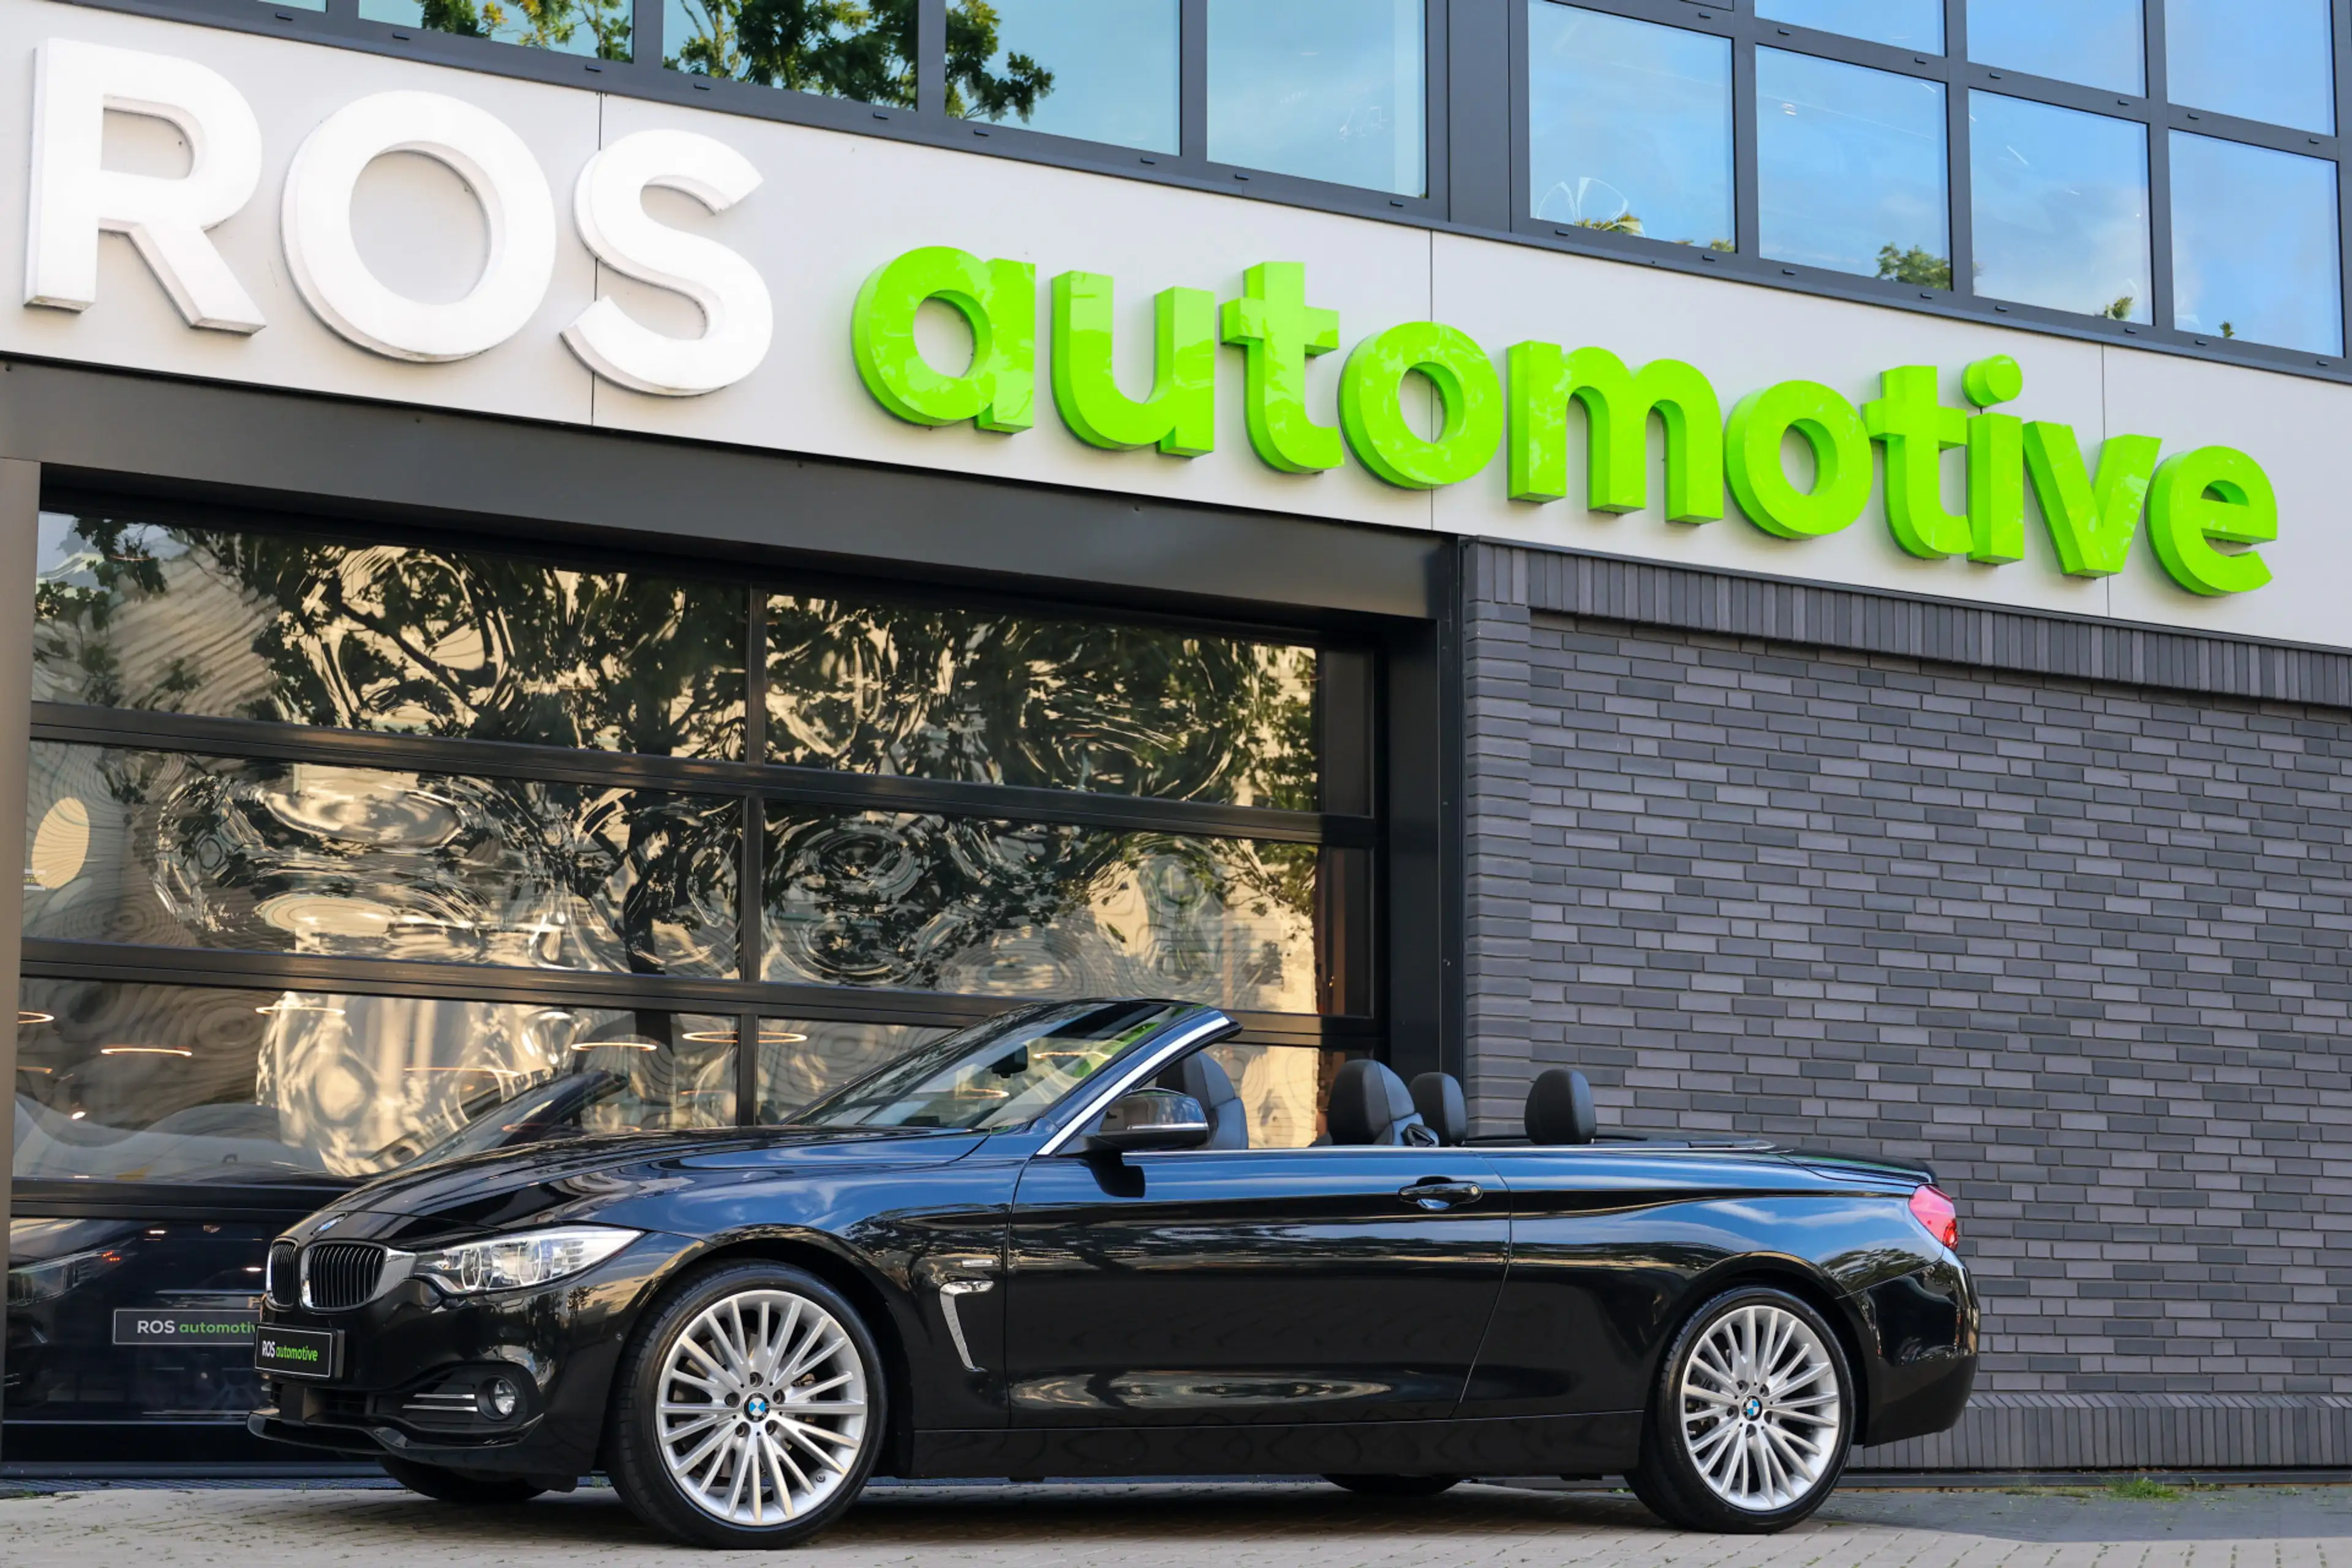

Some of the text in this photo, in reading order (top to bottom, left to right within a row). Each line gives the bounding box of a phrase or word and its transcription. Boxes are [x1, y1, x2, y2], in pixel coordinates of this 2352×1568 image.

[24, 37, 2278, 597] ROS automotive
[137, 1320, 256, 1334] ROS automoti
[262, 1340, 318, 1362] ROS automotive
